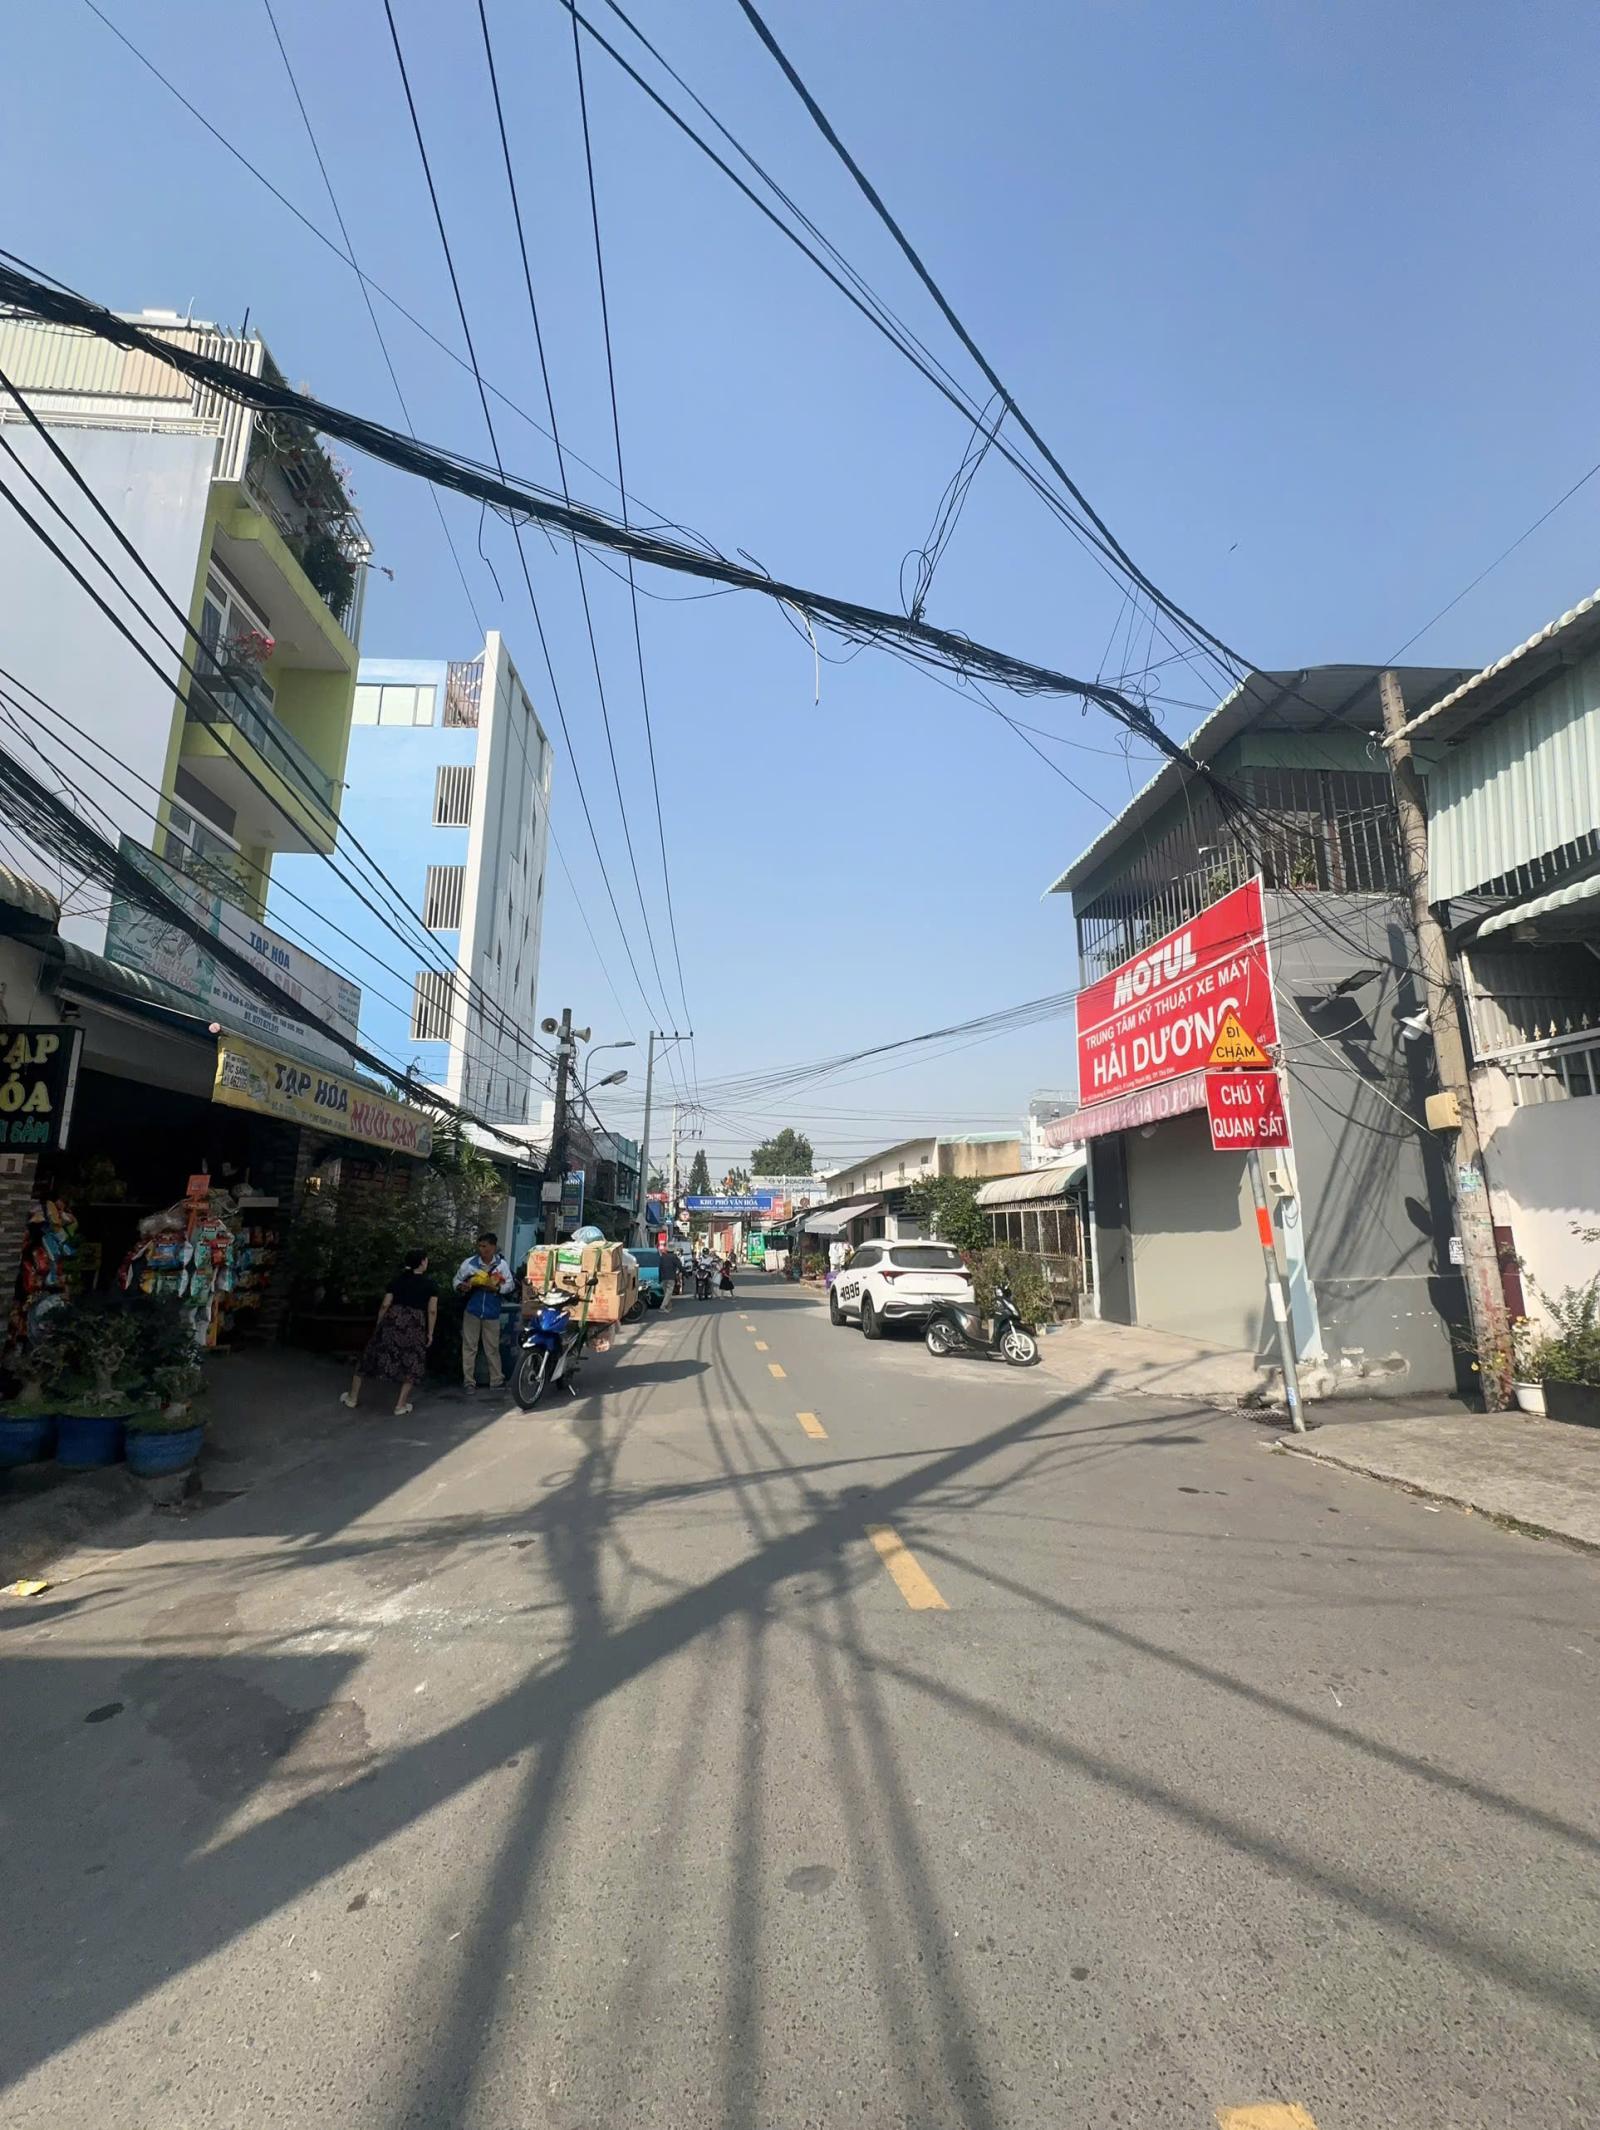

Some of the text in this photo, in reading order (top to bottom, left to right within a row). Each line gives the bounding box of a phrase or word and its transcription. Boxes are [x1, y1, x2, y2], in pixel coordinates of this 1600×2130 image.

[1113, 932, 1197, 1010] MOTUL
[1085, 1021, 1115, 1051] TRUNG
[1116, 1013, 1137, 1038] TÂM
[1154, 986, 1194, 1018] THUẬT
[1195, 974, 1215, 997] XE
[1218, 956, 1250, 987] MÁY
[1226, 1027, 1240, 1038] ĐI
[1093, 1044, 1127, 1088] HẢI
[1216, 1043, 1256, 1062] CHẬM
[0, 1072, 54, 1113] ÓA
[274, 1062, 311, 1099] TẠP
[314, 1079, 348, 1113] HÓA
[1221, 1080, 1267, 1105] CHÚ Ý
[10, 1115, 49, 1144] SÂM
[1213, 1110, 1283, 1139] QUAN SÁT
[715, 1197, 729, 1206] PHỐ
[730, 1198, 744, 1206] VĂN
[744, 1197, 758, 1206] HÓA
